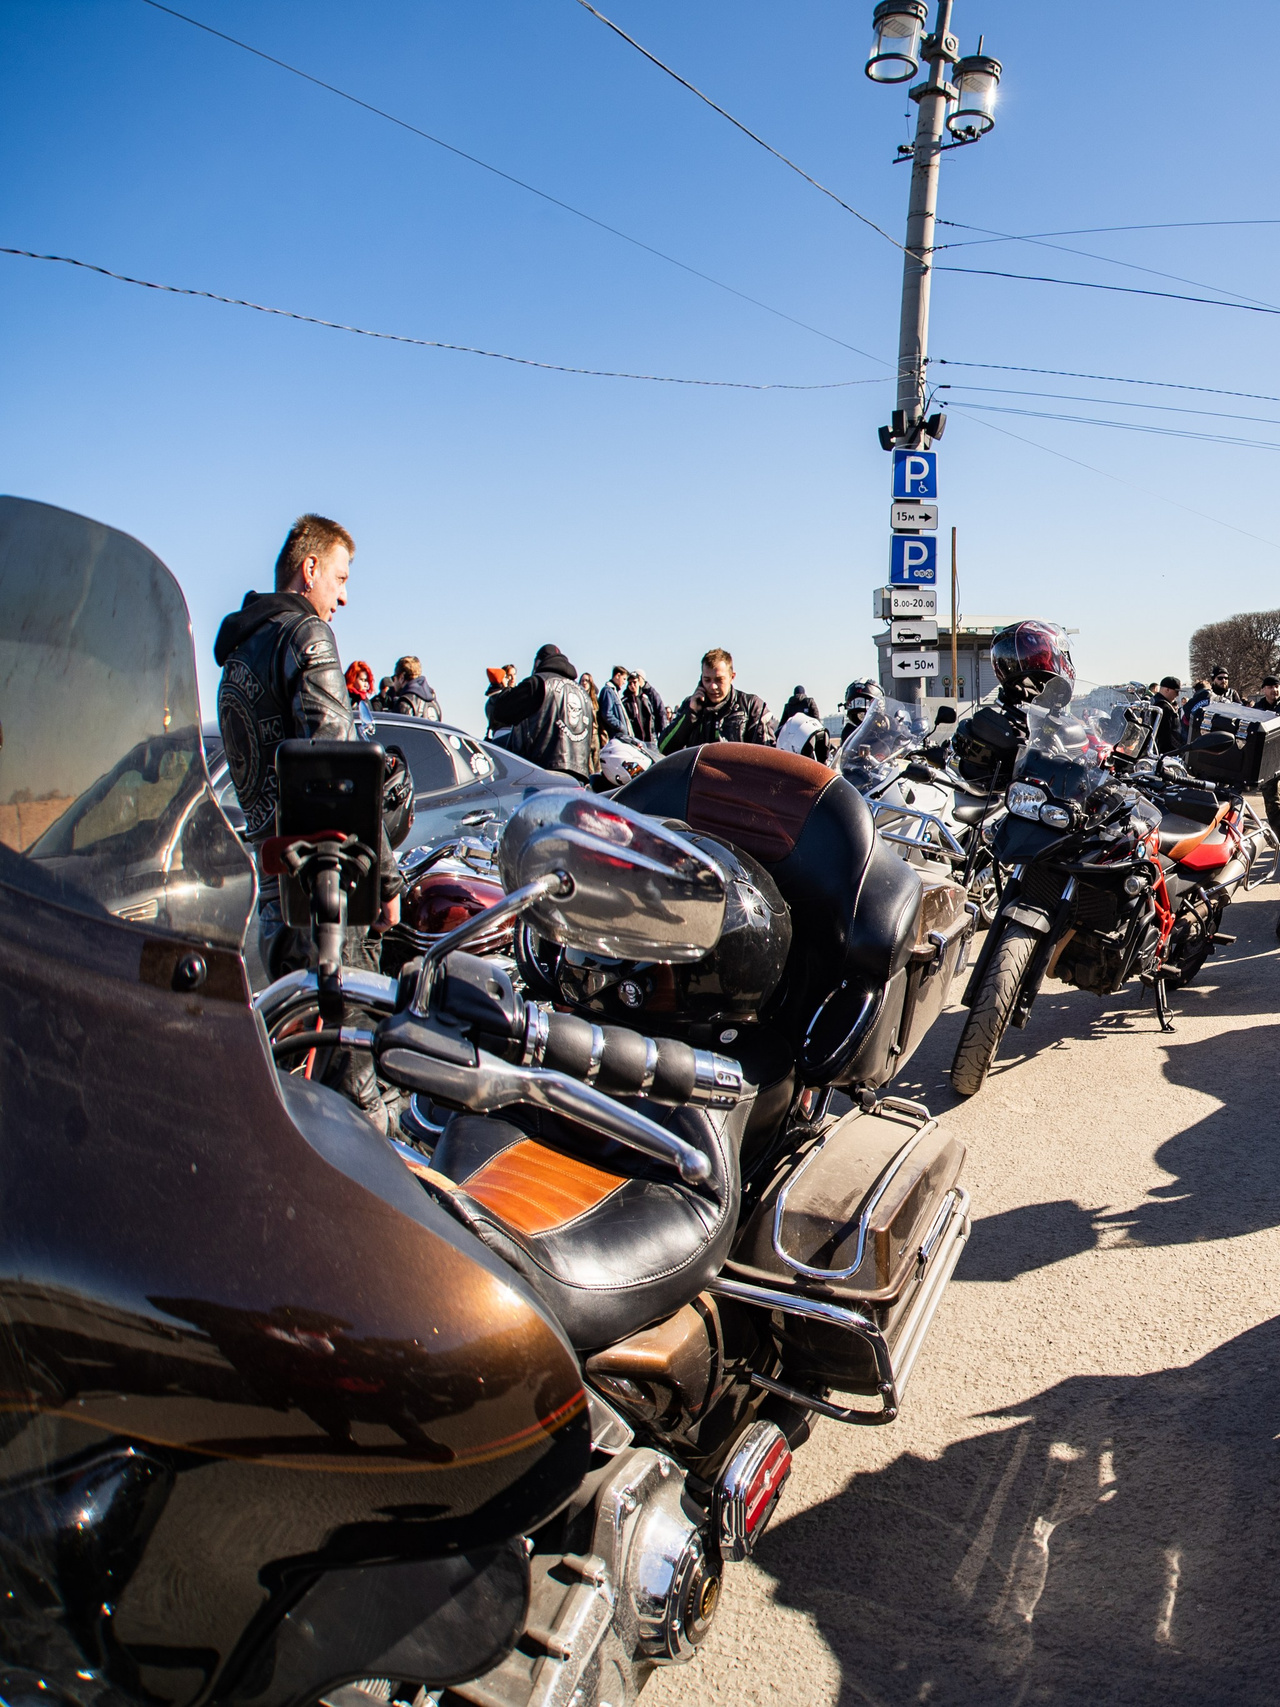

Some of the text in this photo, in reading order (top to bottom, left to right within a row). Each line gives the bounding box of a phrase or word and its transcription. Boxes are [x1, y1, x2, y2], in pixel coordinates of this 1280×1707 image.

[905, 456, 930, 493] P
[903, 540, 929, 579] P
[893, 599, 935, 608] 8.00-20.00
[230, 662, 260, 699] RIDERS
[261, 722, 283, 742] MC
